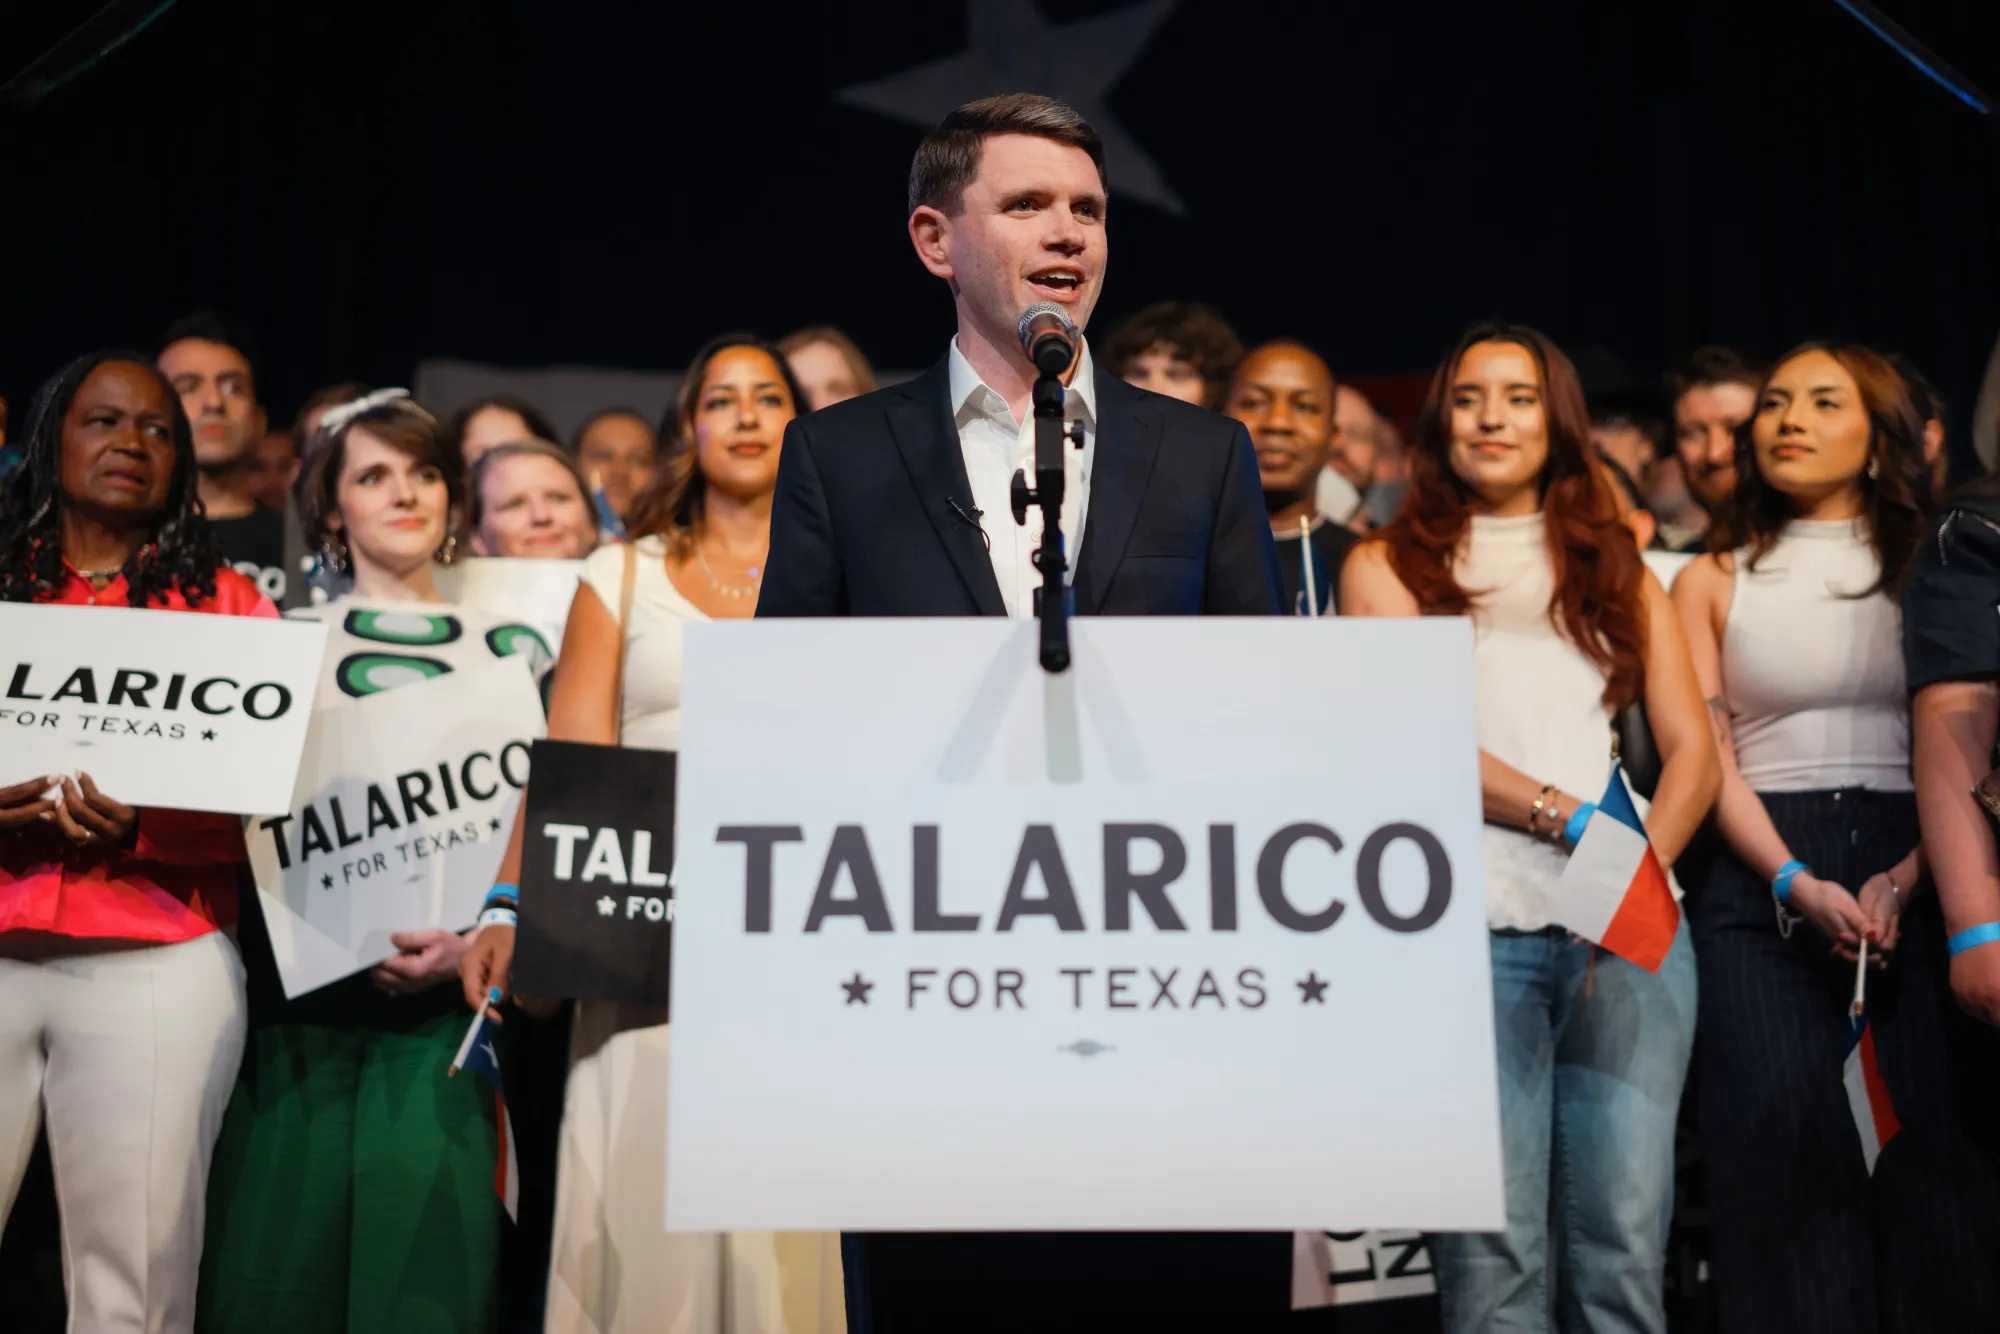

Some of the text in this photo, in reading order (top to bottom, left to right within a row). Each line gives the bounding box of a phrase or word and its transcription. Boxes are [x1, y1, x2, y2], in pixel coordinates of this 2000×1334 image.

[78, 714, 187, 739] TEXAS
[259, 740, 532, 870] TALARICO
[342, 822, 480, 884] FOR TEXAS
[543, 823, 677, 888] TAL
[715, 822, 1453, 933] TALARICO
[907, 968, 1268, 1010] FOR TEXAS
